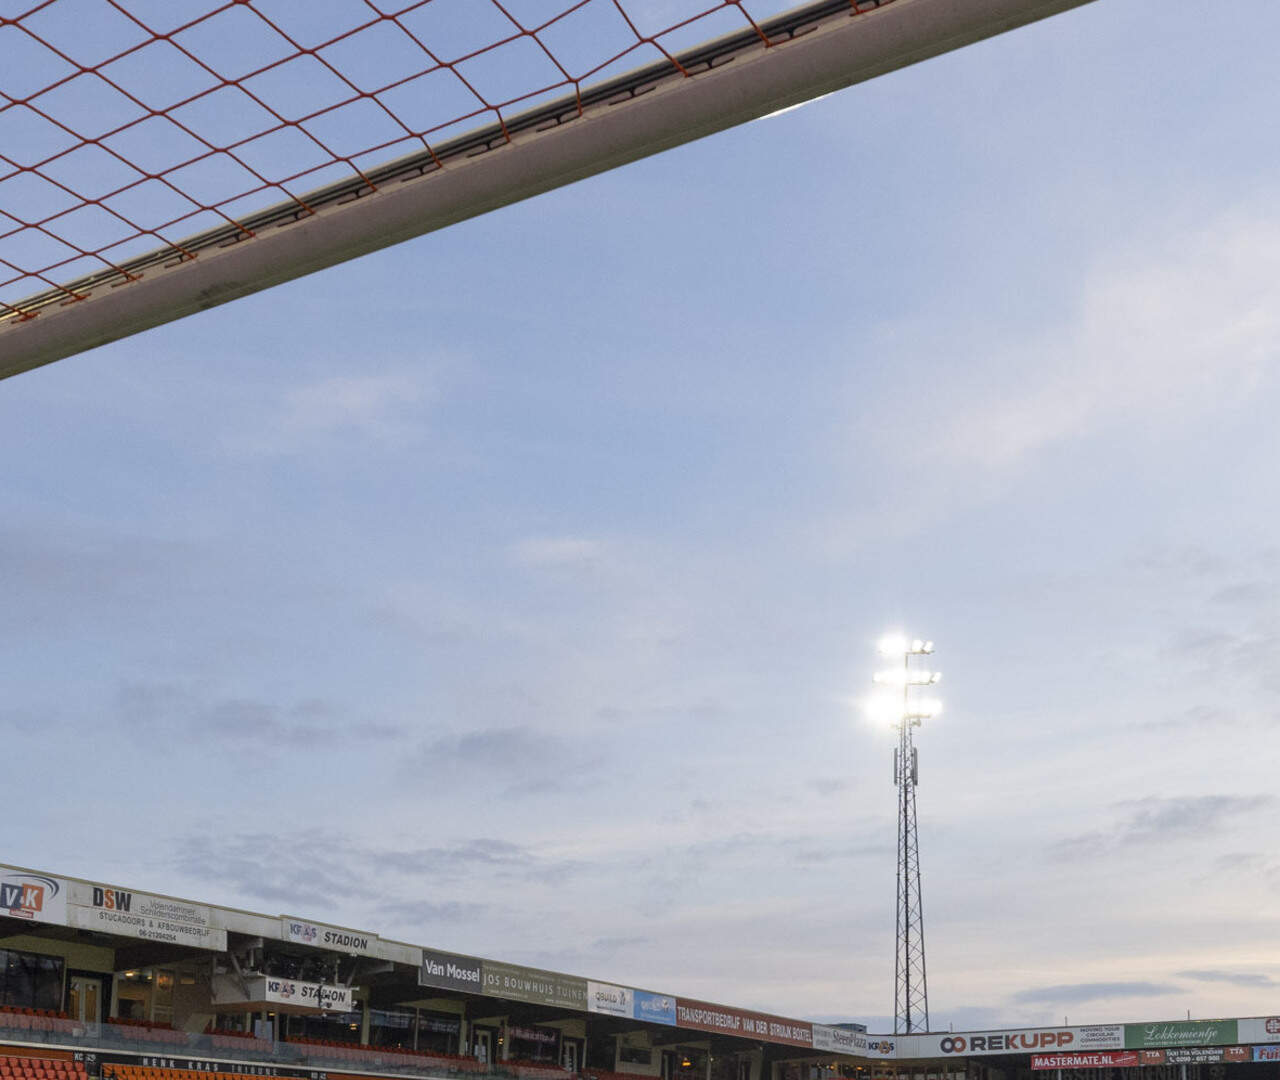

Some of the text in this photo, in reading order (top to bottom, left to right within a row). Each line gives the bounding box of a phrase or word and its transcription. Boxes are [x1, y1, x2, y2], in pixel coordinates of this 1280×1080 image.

[93, 887, 131, 912] DSW
[324, 931, 368, 950] STADION
[425, 960, 480, 983] Van Mossel
[483, 973, 500, 986] JOS
[504, 977, 553, 995] BOUWHUIS
[301, 986, 346, 1002] STAON
[970, 1032, 1074, 1051] REKUPP
[1034, 1055, 1114, 1068] MASTERMATE.NL
